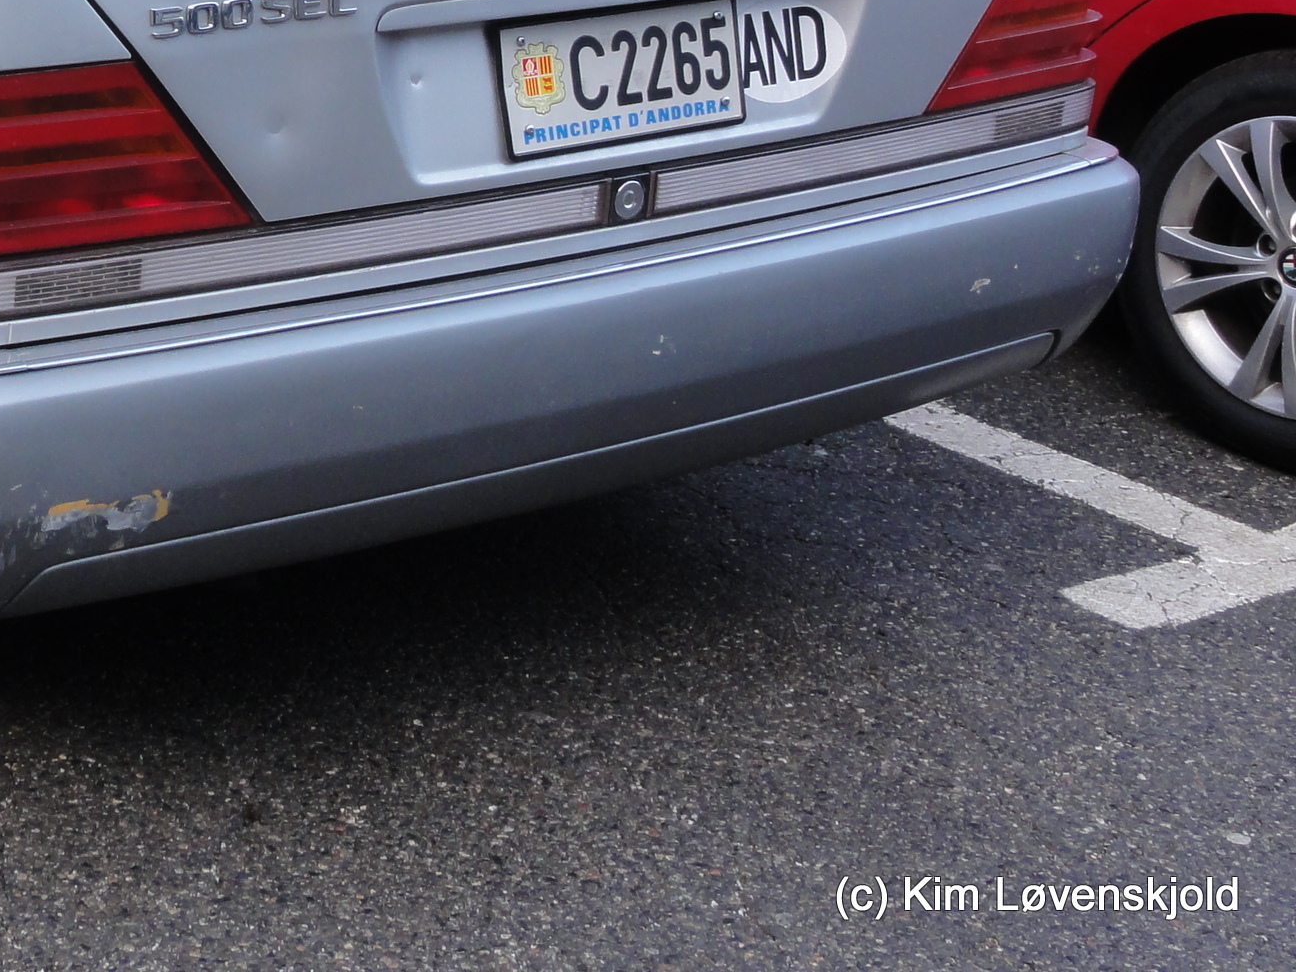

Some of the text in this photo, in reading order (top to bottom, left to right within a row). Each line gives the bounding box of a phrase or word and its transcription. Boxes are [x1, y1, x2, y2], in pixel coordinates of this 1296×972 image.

[569, 15, 731, 111] C2265
[742, 6, 827, 89] AND
[524, 98, 730, 145] PRINCIPAT D'ANDORRA
